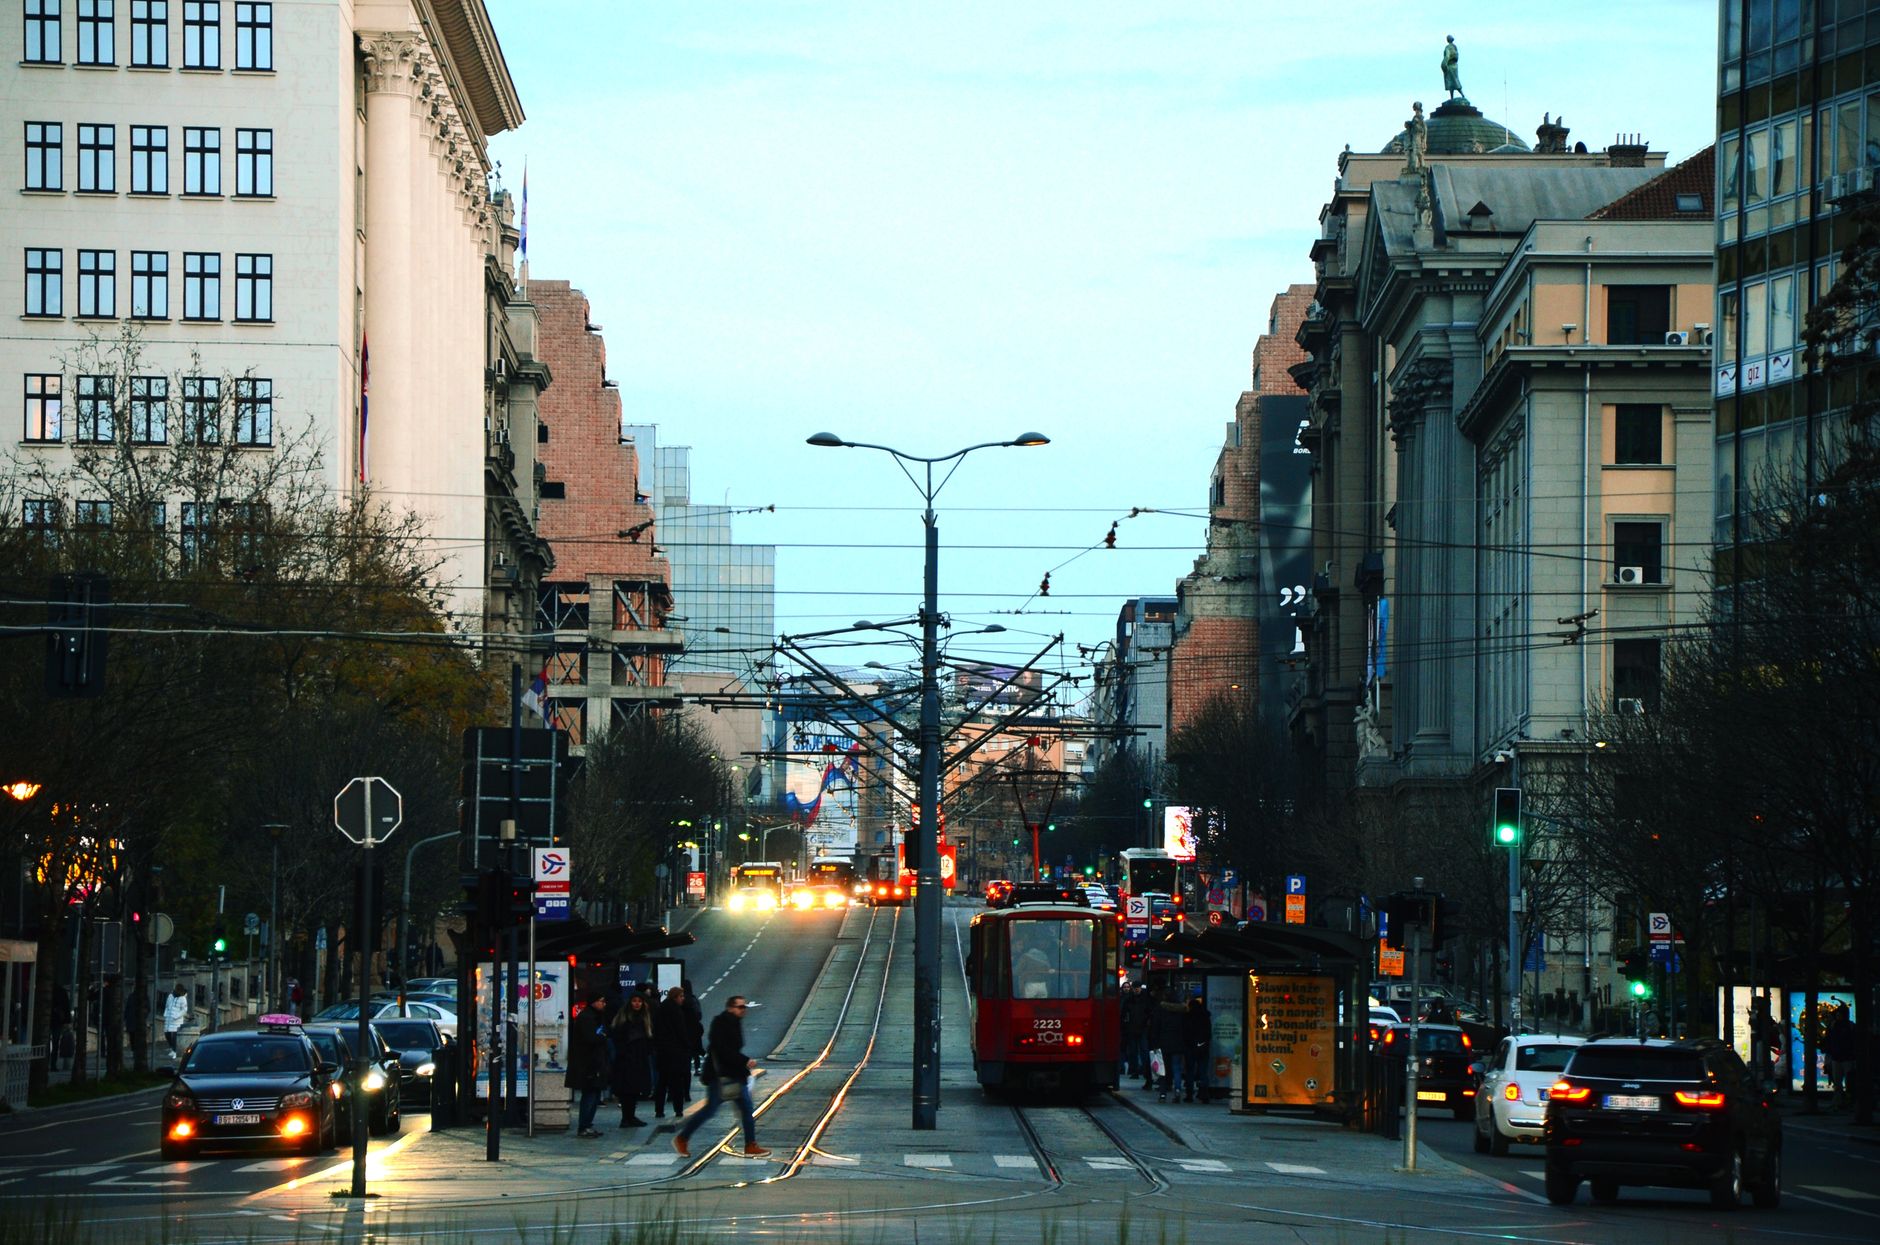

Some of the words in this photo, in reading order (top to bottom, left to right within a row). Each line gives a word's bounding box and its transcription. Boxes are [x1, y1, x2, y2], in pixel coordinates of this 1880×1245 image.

[1748, 365, 1759, 385] giz
[689, 877, 703, 886] 26
[1291, 878, 1301, 893] P
[1033, 1019, 1062, 1029] 2223
[1256, 1044, 1294, 1054] tekmi.
